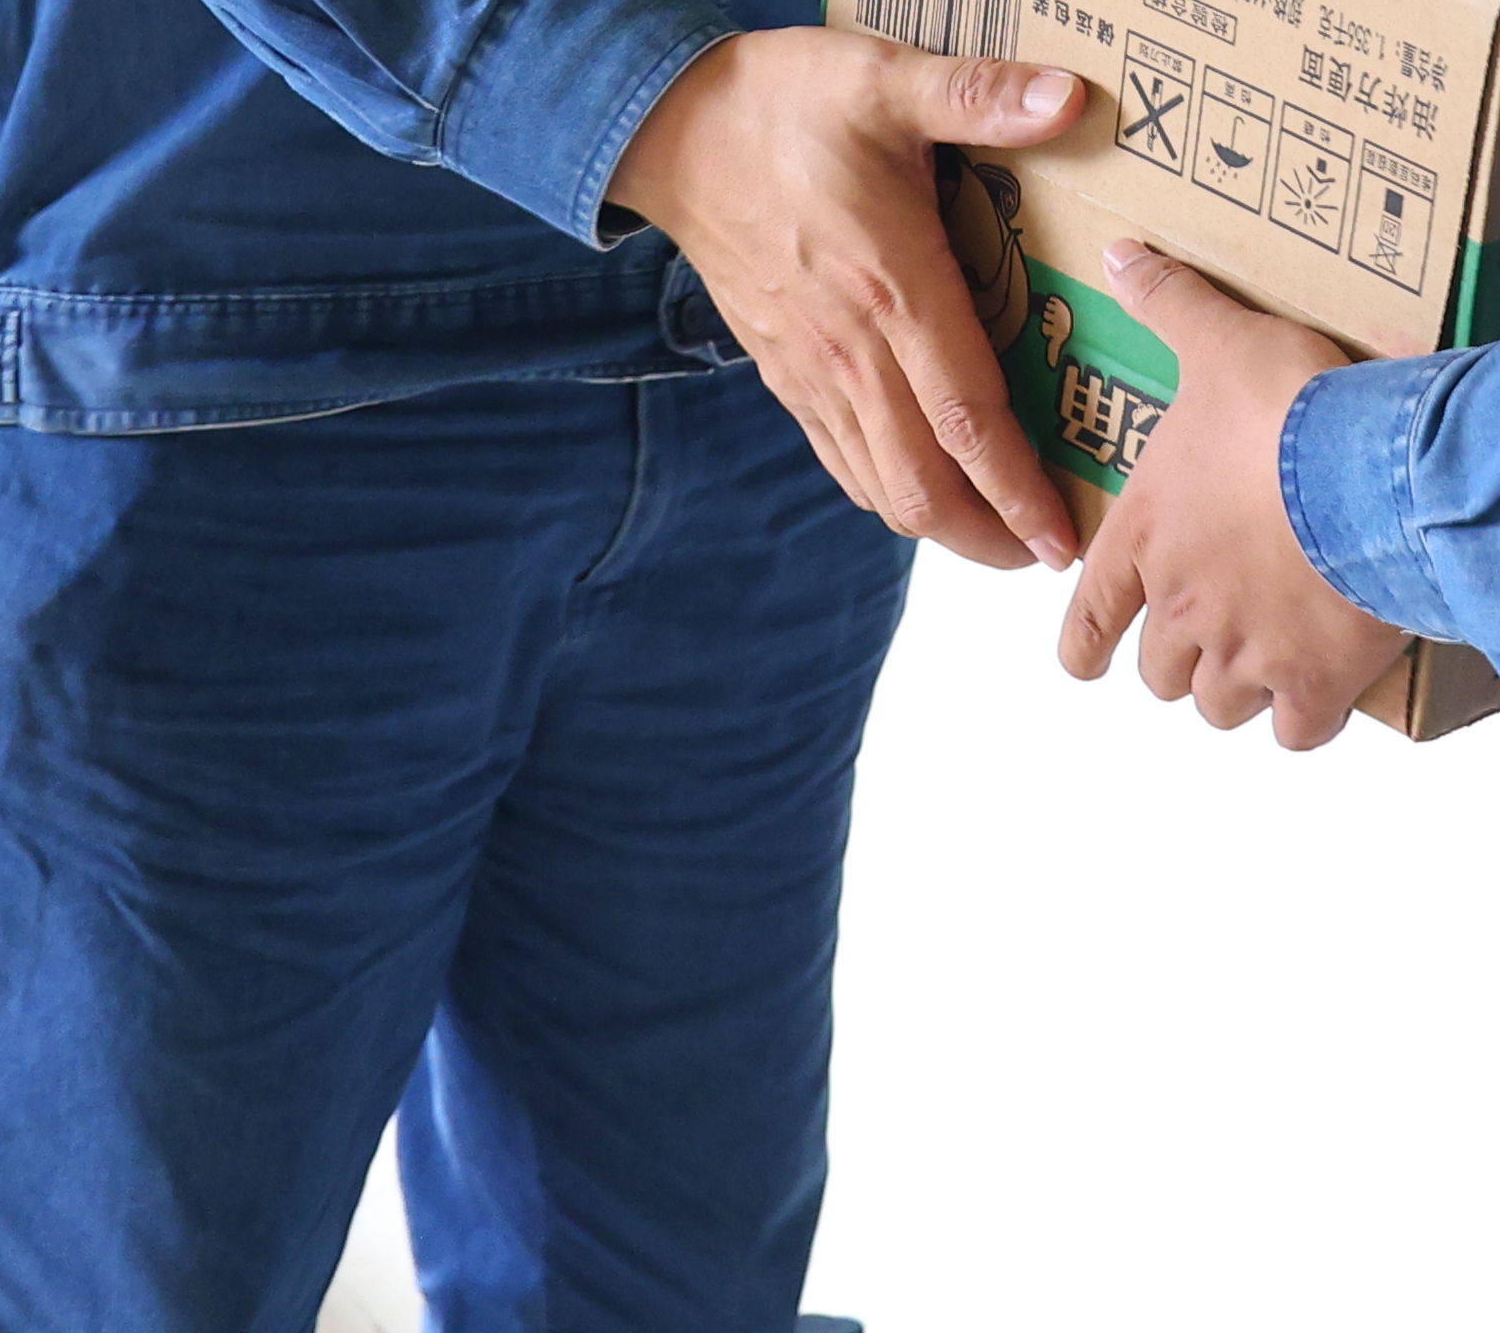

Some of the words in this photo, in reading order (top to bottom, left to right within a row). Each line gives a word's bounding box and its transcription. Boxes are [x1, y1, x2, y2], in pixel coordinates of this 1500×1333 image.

[1299, 44, 1439, 141] 油炸方便面
